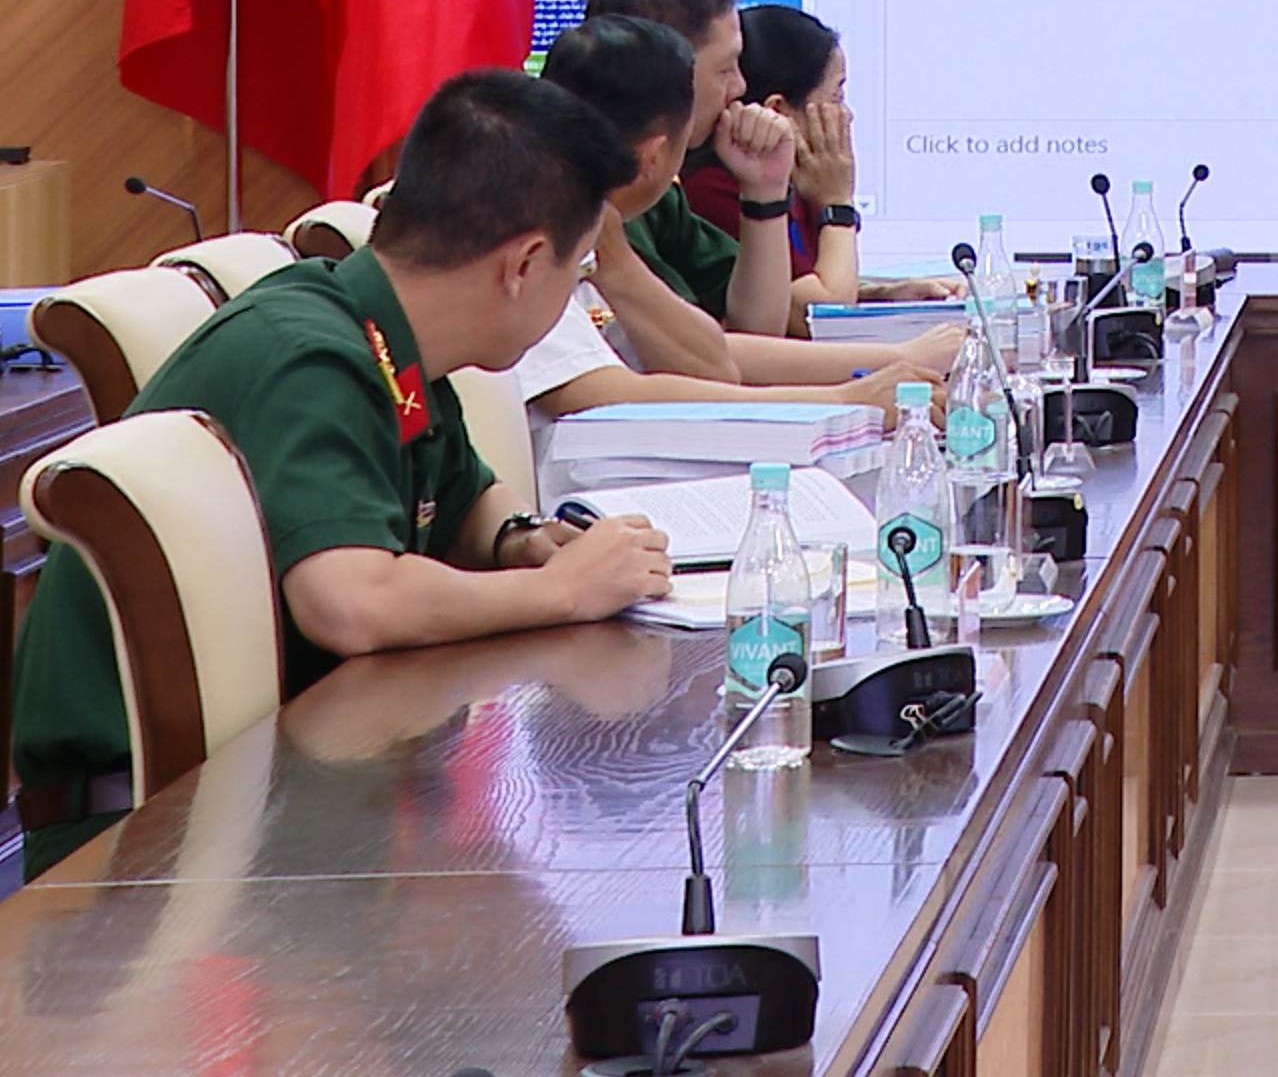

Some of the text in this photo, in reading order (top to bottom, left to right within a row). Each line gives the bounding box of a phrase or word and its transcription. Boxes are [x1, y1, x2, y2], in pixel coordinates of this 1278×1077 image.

[907, 135, 1107, 153] Click to add notes
